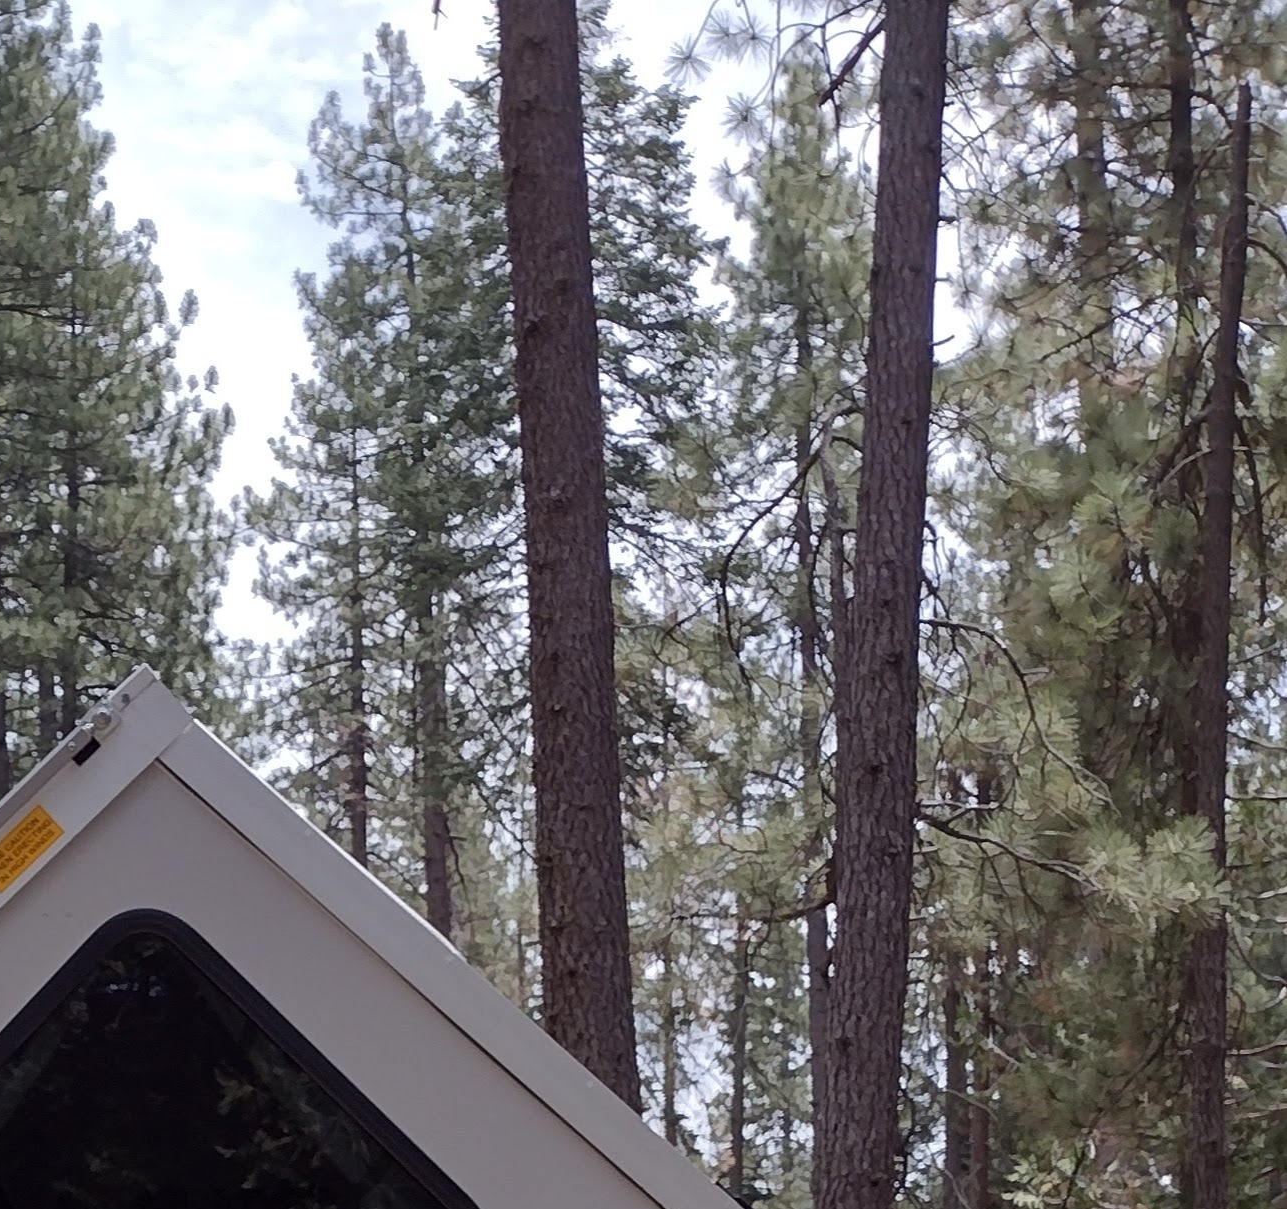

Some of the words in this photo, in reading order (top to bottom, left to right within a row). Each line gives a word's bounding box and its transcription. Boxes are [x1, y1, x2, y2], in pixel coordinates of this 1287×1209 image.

[4, 817, 39, 851] CAUTION
[12, 819, 52, 857] ERECTING
[0, 873, 10, 883] IN
[9, 855, 29, 874] HIGH
[27, 828, 55, 855] WINDS
